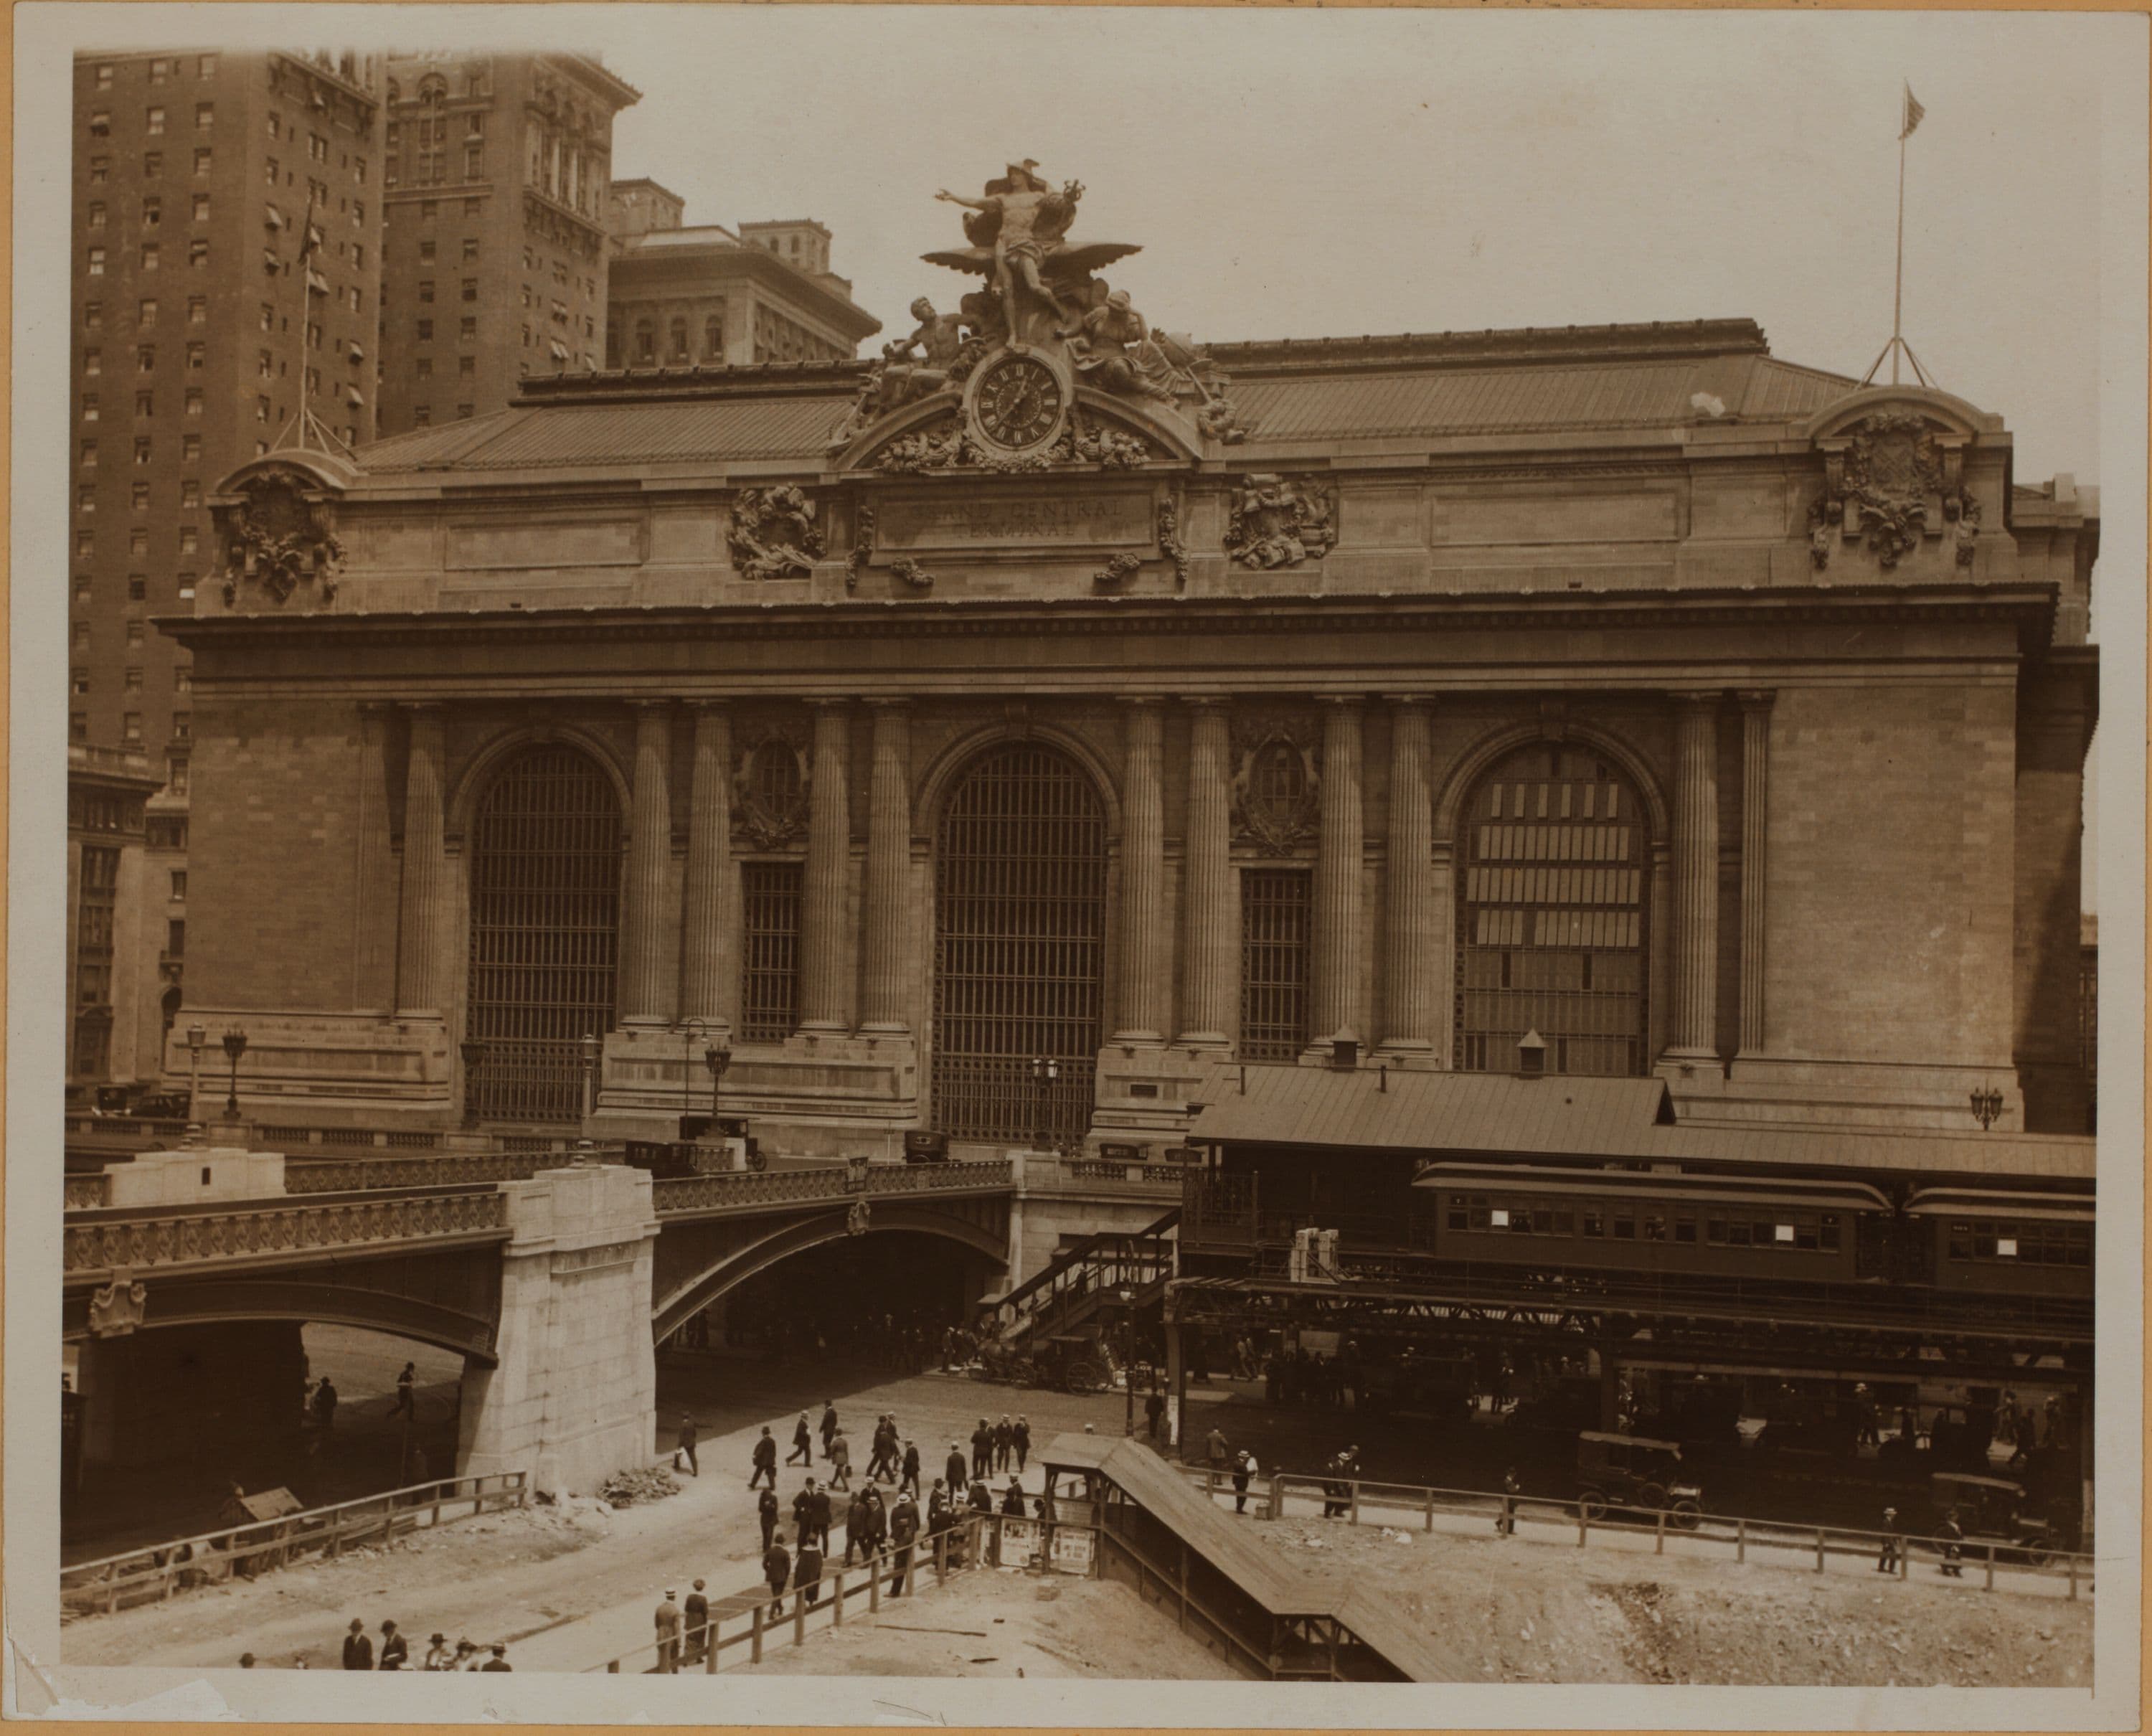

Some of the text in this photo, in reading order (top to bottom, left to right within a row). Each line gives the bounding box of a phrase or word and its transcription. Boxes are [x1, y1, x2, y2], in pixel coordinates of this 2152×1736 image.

[911, 500, 1123, 520] GRAND CENTRAL
[956, 520, 1075, 539] ERMINAL
